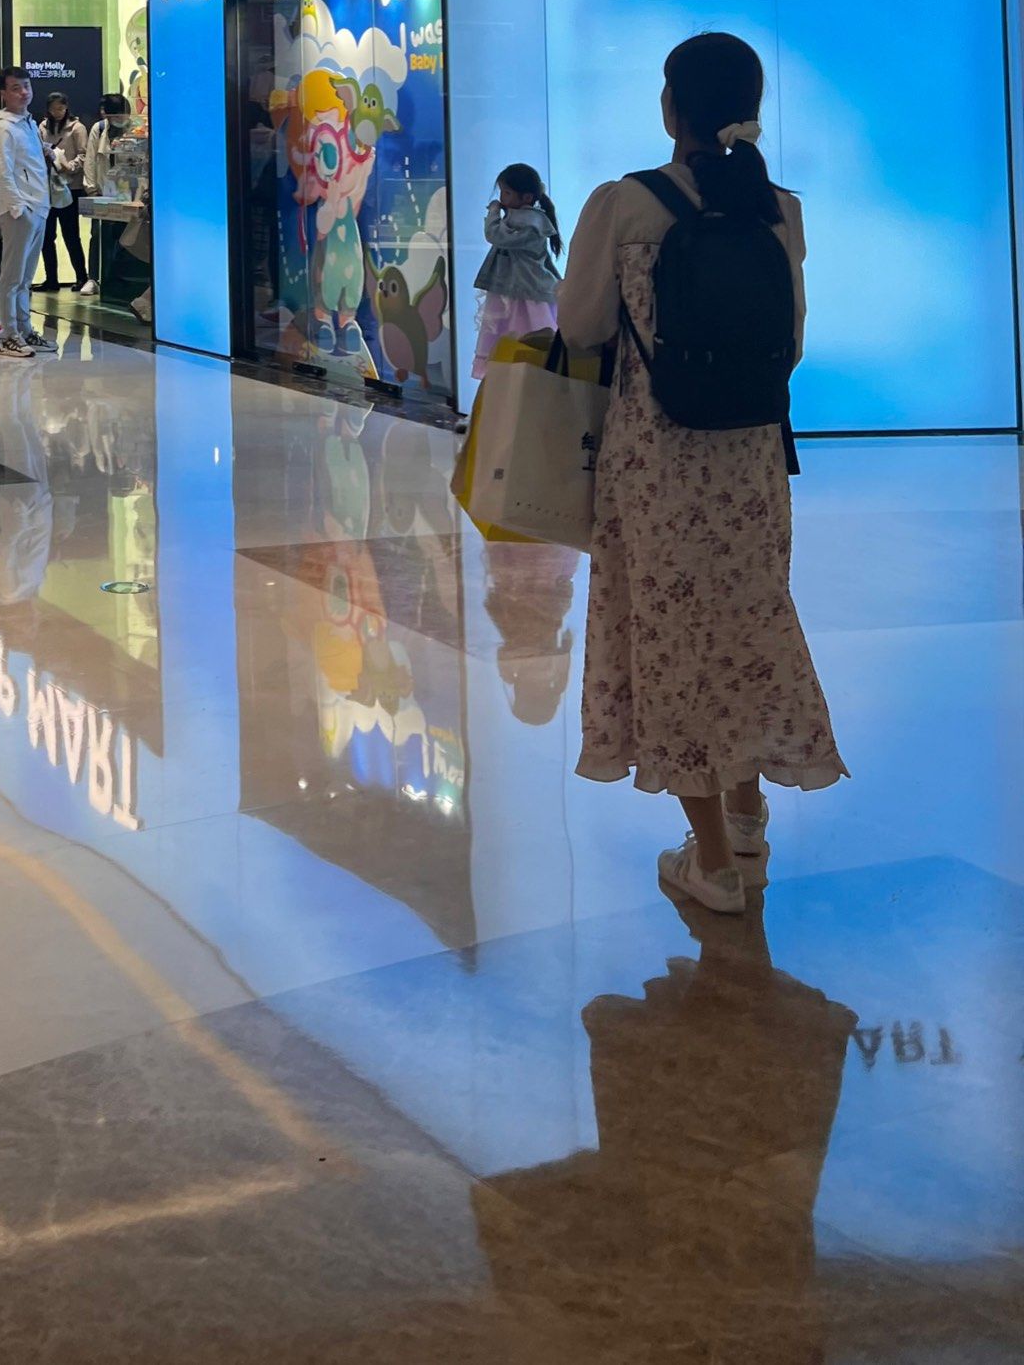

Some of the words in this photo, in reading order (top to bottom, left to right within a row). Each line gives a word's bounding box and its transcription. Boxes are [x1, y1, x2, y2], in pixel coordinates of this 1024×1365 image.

[25, 62, 44, 70] Baby
[44, 62, 65, 70] Molly
[410, 53, 436, 75] Baby
